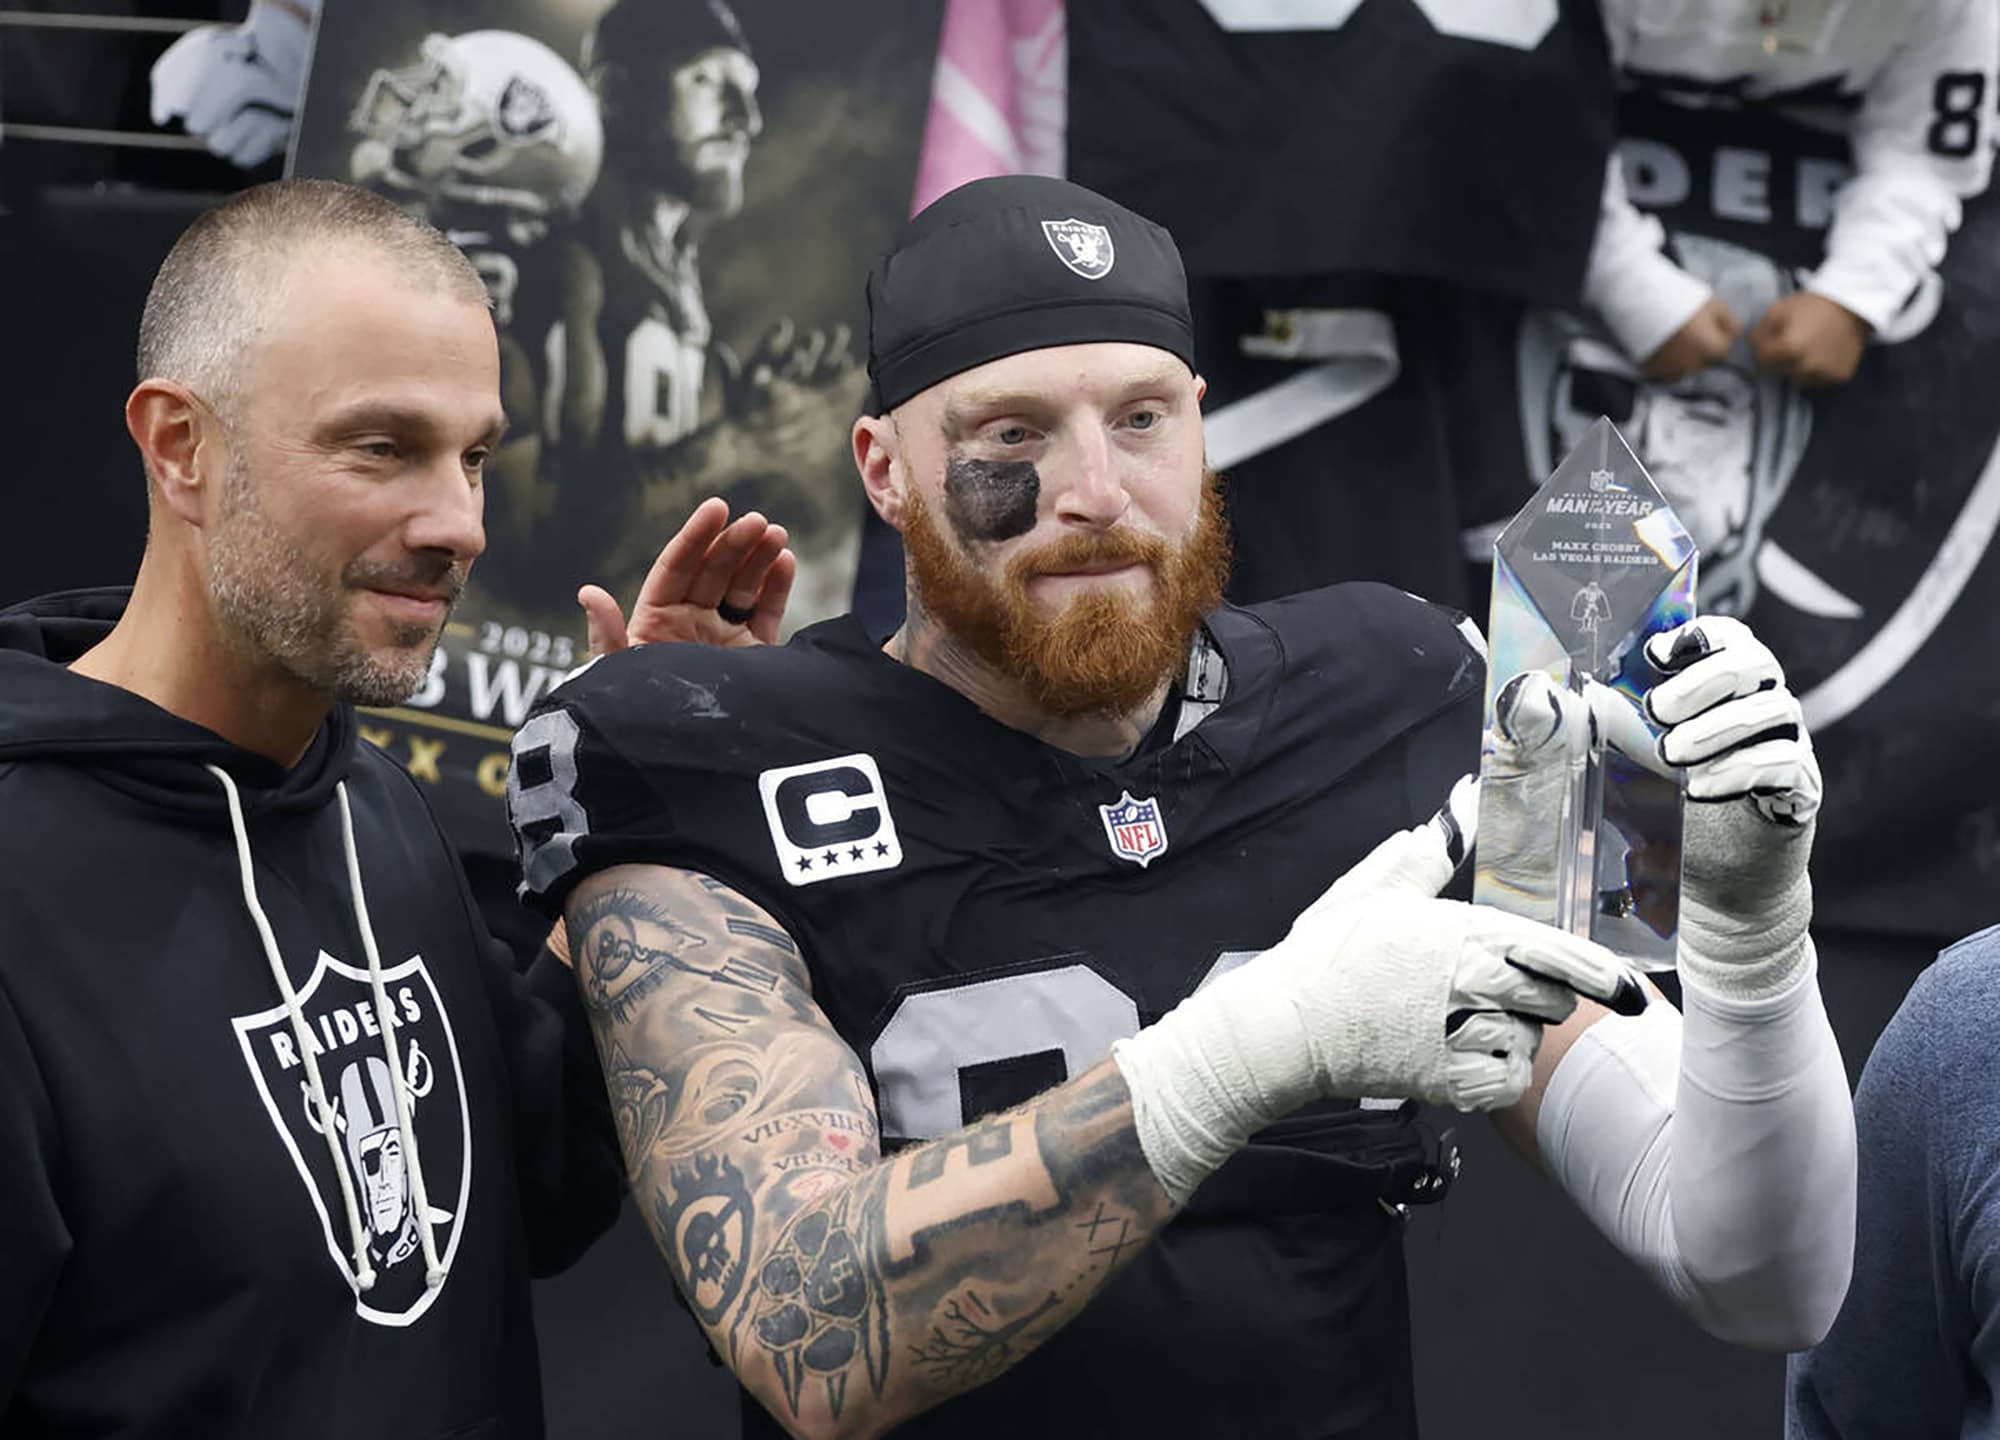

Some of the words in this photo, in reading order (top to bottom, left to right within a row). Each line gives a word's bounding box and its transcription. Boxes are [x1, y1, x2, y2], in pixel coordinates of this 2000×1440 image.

[1927, 71, 1986, 159] 8
[1546, 498, 1589, 514] MAN
[1604, 499, 1654, 517] YEAR
[1532, 552, 1557, 561] LAS
[1559, 552, 1601, 563] VEGAS
[479, 620, 575, 669] 2025
[466, 651, 567, 726] W
[775, 766, 881, 849] C
[1117, 823, 1159, 852] NFL
